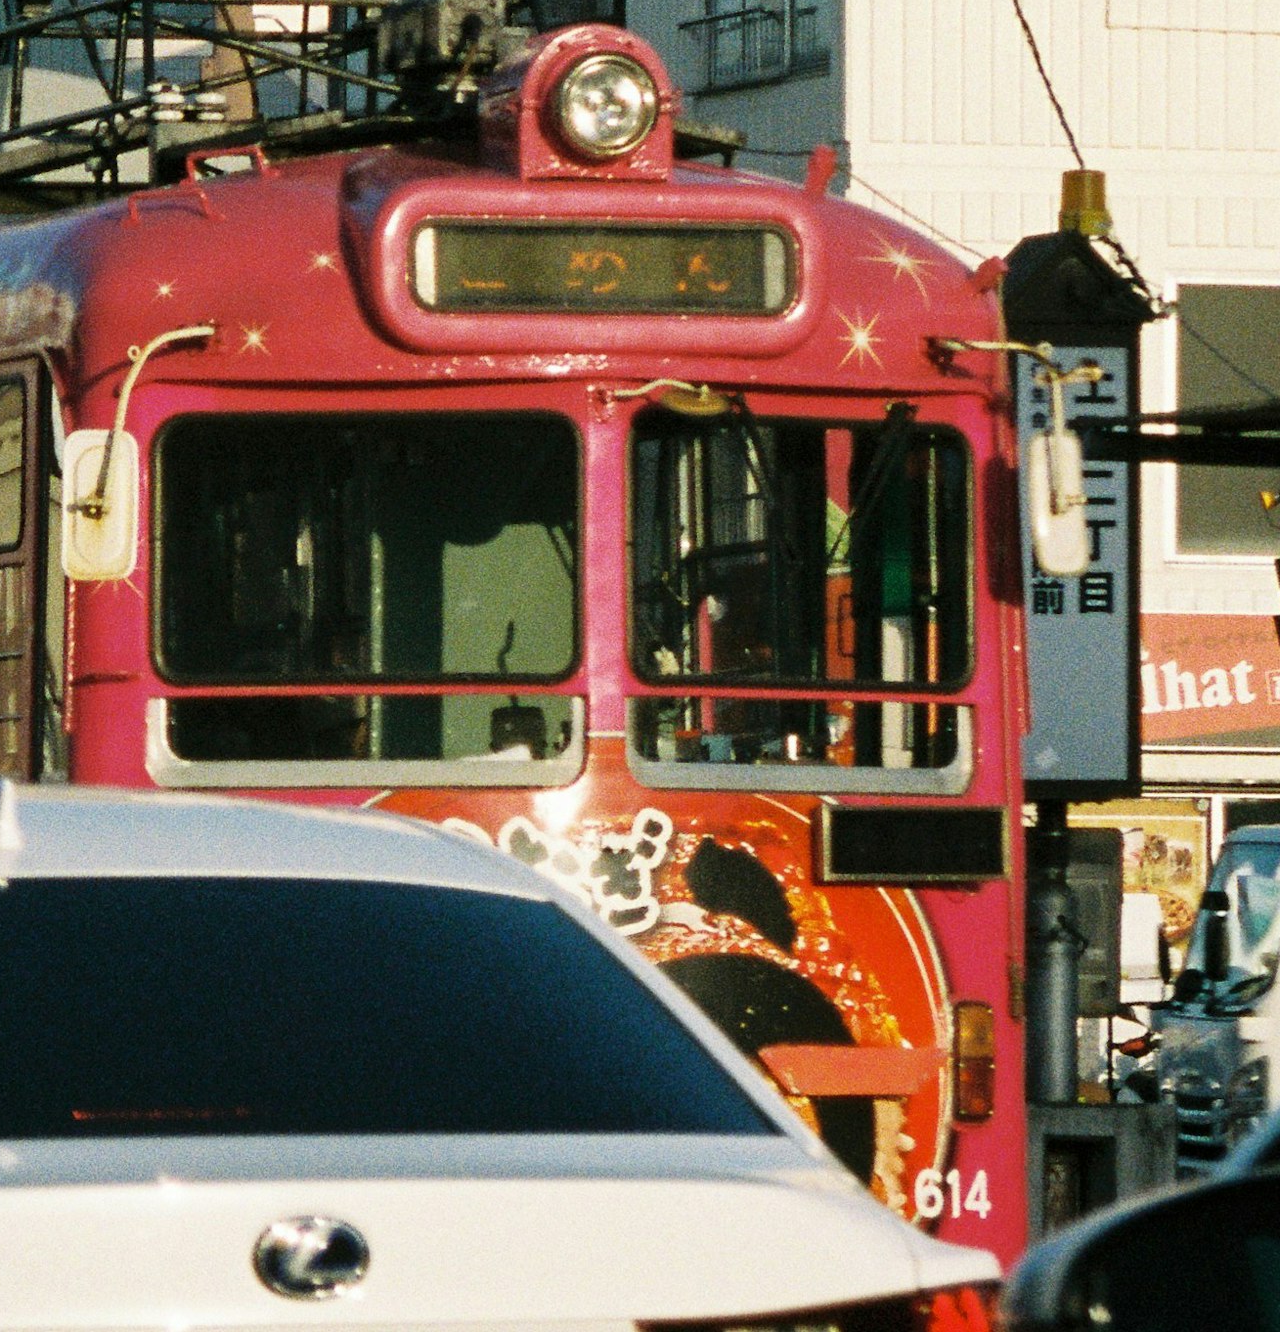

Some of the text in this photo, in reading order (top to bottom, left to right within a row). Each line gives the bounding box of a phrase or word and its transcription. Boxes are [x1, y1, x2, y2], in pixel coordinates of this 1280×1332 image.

[1075, 358, 1117, 614] 上二丁目
[915, 1168, 992, 1220] 614
